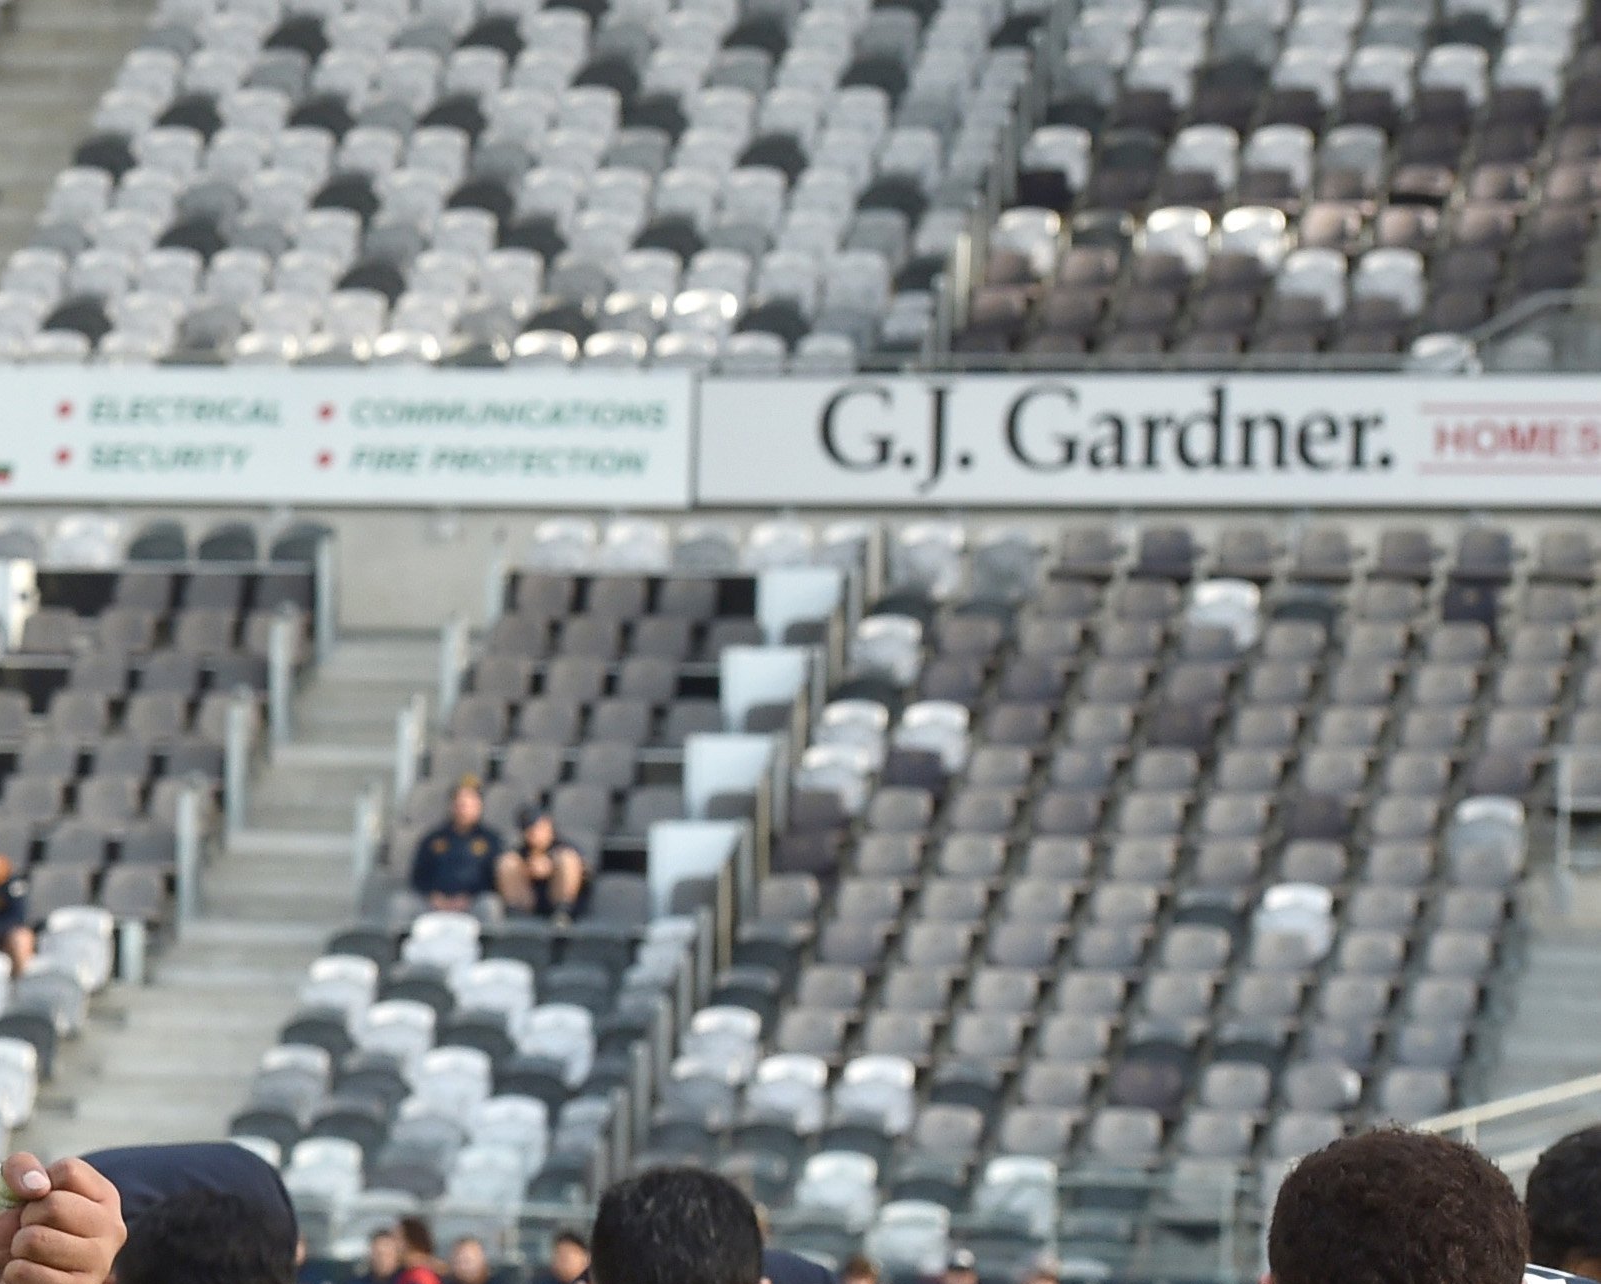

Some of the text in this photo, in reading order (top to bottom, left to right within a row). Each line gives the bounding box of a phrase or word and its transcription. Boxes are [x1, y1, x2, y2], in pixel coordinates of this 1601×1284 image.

[89, 398, 281, 428] ELECTRICAL
[348, 398, 667, 430] COMMUNICATIONS
[819, 382, 1394, 494] G.J. Gardner.
[88, 445, 252, 474] SECURITY
[348, 445, 650, 477] FIRE PROTECTION
